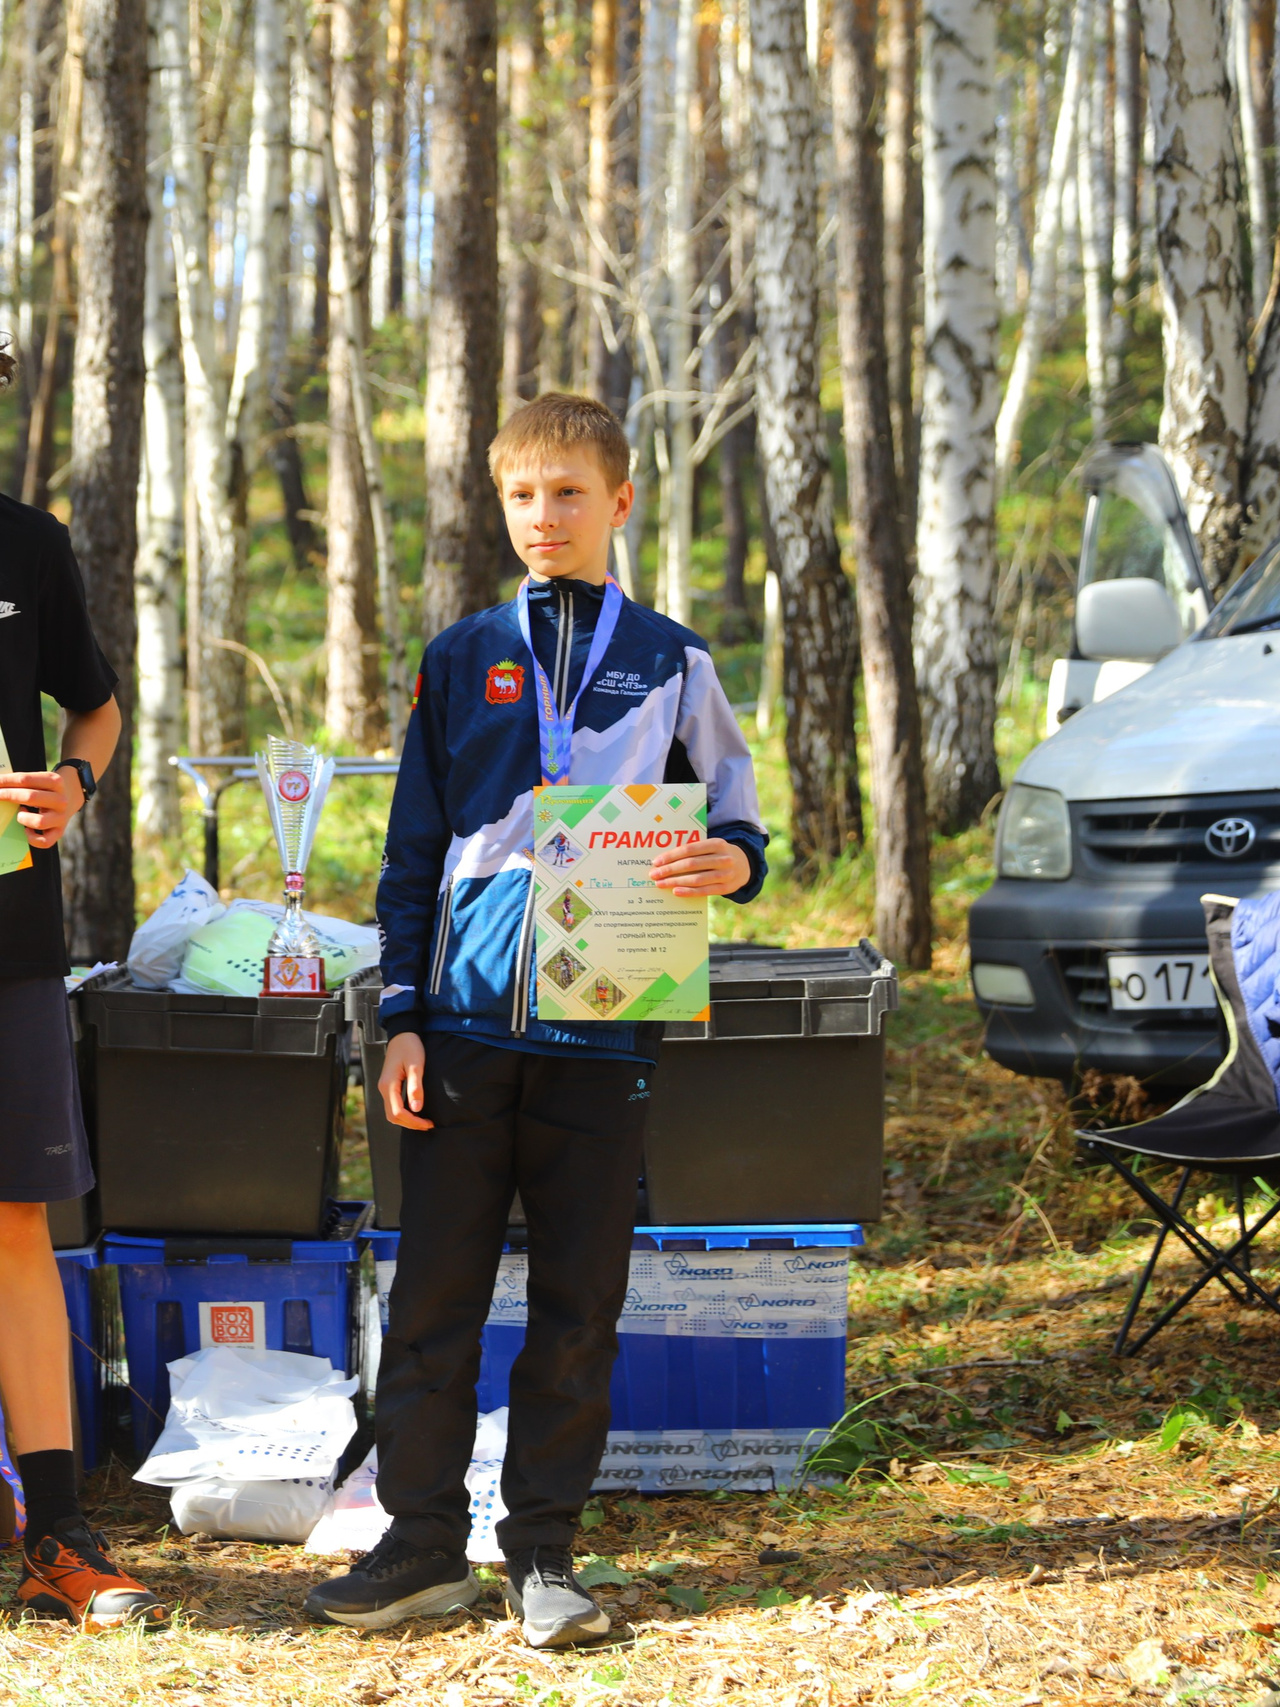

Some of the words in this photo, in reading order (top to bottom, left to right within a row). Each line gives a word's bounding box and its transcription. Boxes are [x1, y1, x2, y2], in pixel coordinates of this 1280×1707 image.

[606, 671, 625, 679] МБУ
[626, 673, 641, 681] ДО
[588, 830, 701, 849] ГРАМОТА
[617, 859, 653, 867] НАГРАЖД
[308, 972, 317, 991] 1
[807, 1258, 849, 1269] NOR
[679, 1268, 734, 1276] NORD
[761, 1299, 816, 1307] NORD
[216, 1312, 250, 1324] ROX
[216, 1325, 250, 1337] BOX
[733, 1322, 788, 1330] NORD
[611, 1444, 695, 1455] NORD
